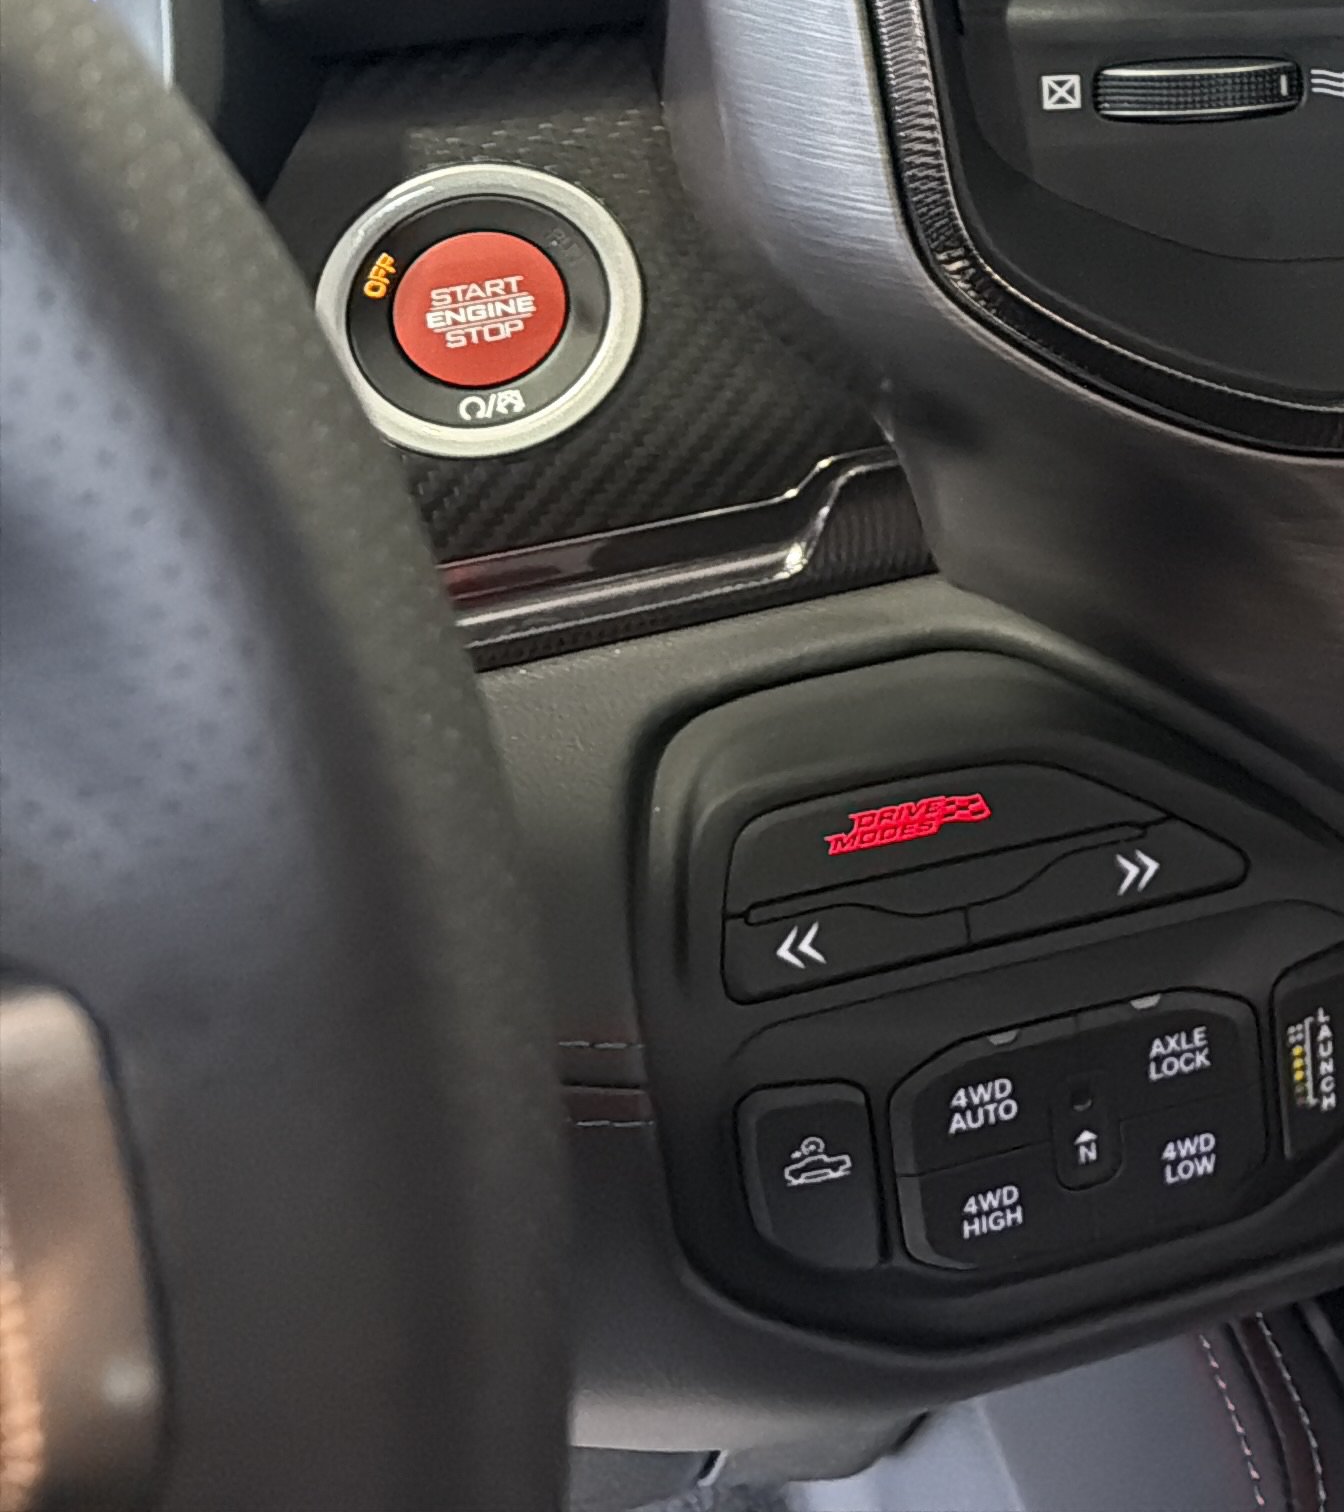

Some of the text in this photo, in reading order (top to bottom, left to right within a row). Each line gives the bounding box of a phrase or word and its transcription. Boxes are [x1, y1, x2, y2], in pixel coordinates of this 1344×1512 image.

[363, 251, 398, 300] OFF
[430, 275, 525, 307] START
[425, 295, 537, 329] ENGINE
[445, 319, 525, 349] STOP
[848, 795, 947, 828] DRIVE
[825, 819, 943, 856] MODES
[1149, 1026, 1209, 1058] AXLE
[1148, 1048, 1212, 1082] LOCK
[1316, 1006, 1337, 1113] LAUNCH
[950, 1077, 1013, 1110] 4WD
[948, 1098, 1019, 1136] AUTO
[1077, 1141, 1098, 1166] N
[1161, 1132, 1216, 1161] 4WD
[1165, 1153, 1217, 1185] LOW
[962, 1184, 1020, 1216] 4WD
[961, 1205, 1024, 1240] HIGH
